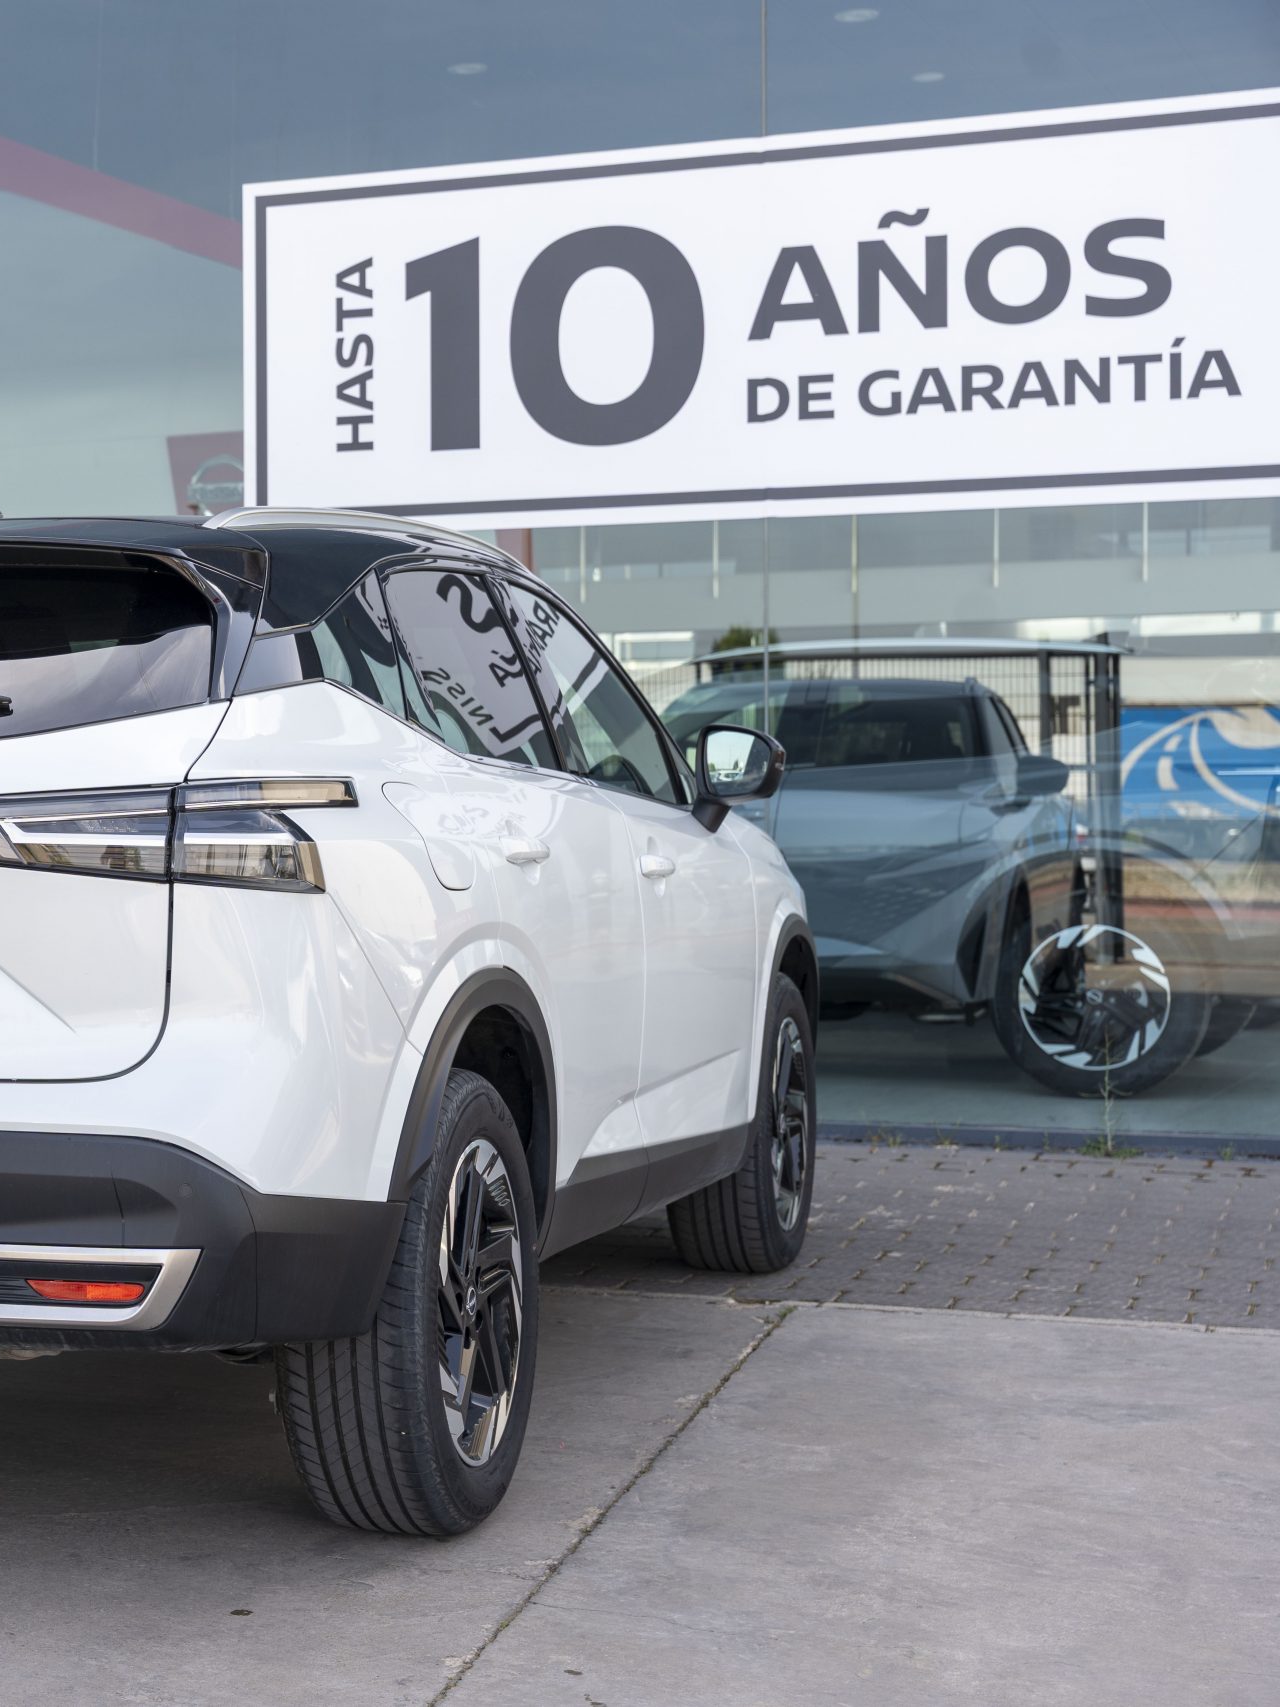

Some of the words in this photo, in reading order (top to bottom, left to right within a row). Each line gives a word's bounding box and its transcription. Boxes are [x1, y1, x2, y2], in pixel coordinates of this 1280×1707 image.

[336, 258, 374, 452] HASTA
[405, 226, 705, 452] 10
[748, 208, 1173, 341] AÑOS
[747, 373, 835, 423] DE
[857, 337, 1242, 417] GARANTÍA
